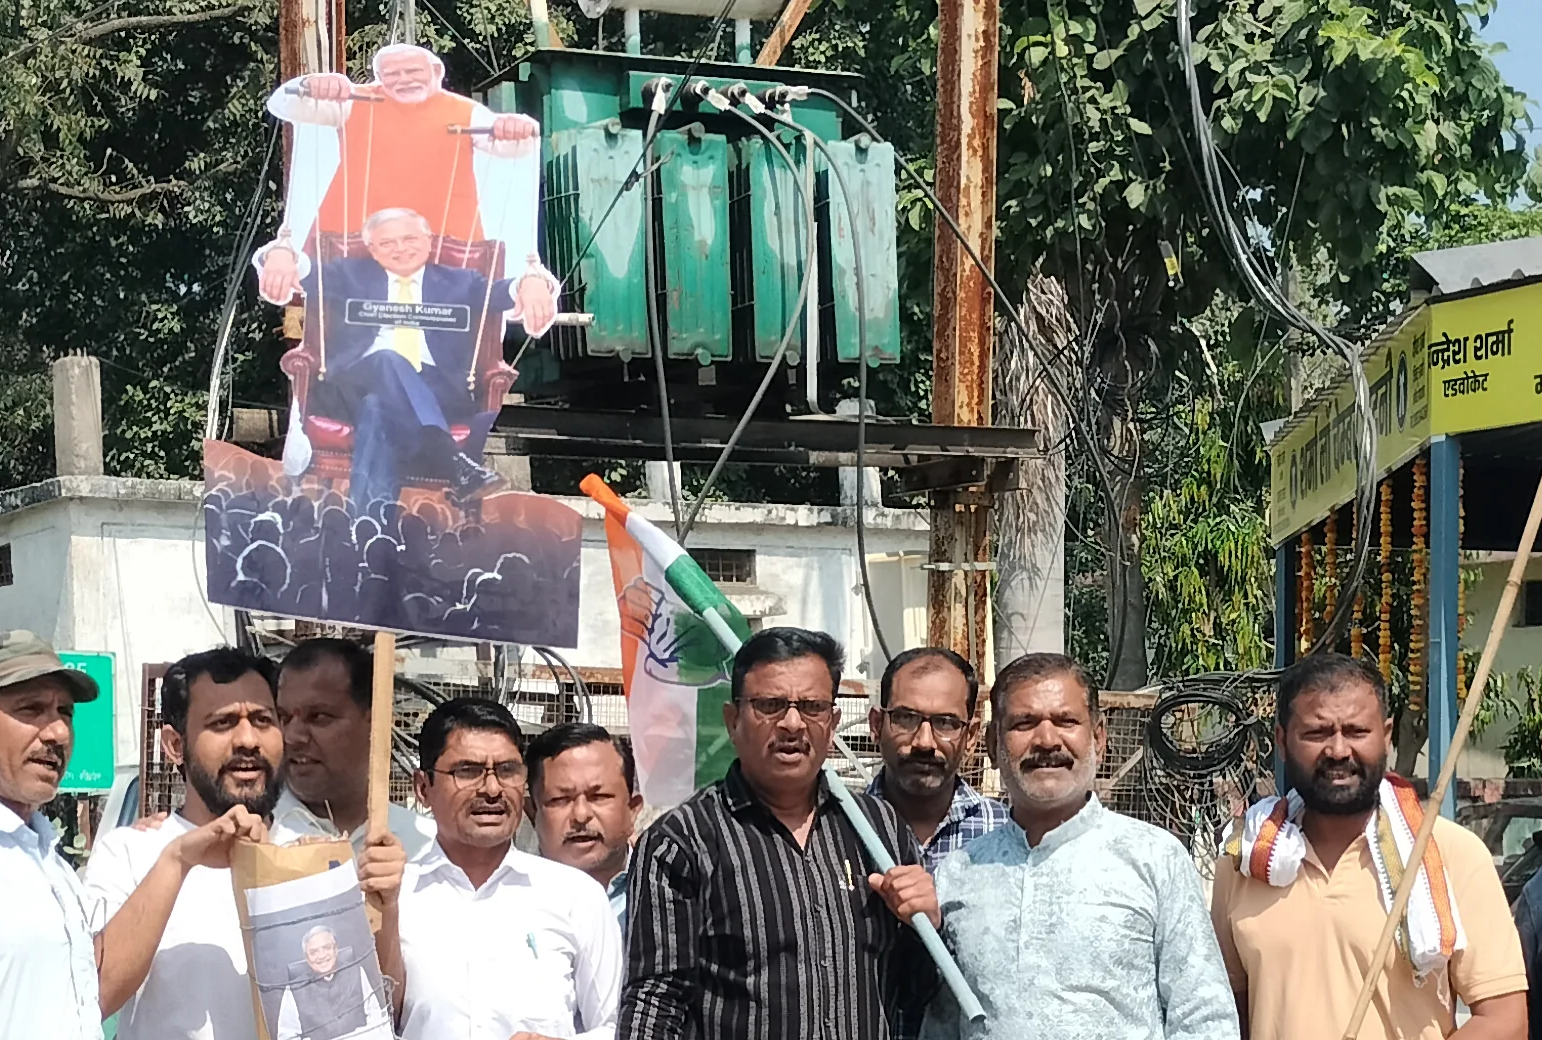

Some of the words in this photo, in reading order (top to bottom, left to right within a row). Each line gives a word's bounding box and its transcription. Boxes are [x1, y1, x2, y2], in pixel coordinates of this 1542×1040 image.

[362, 302, 413, 314] Gyanesh
[415, 304, 453, 316] Kumar
[1473, 319, 1514, 361] शर्मा
[1442, 369, 1490, 398] एडवोकेट
